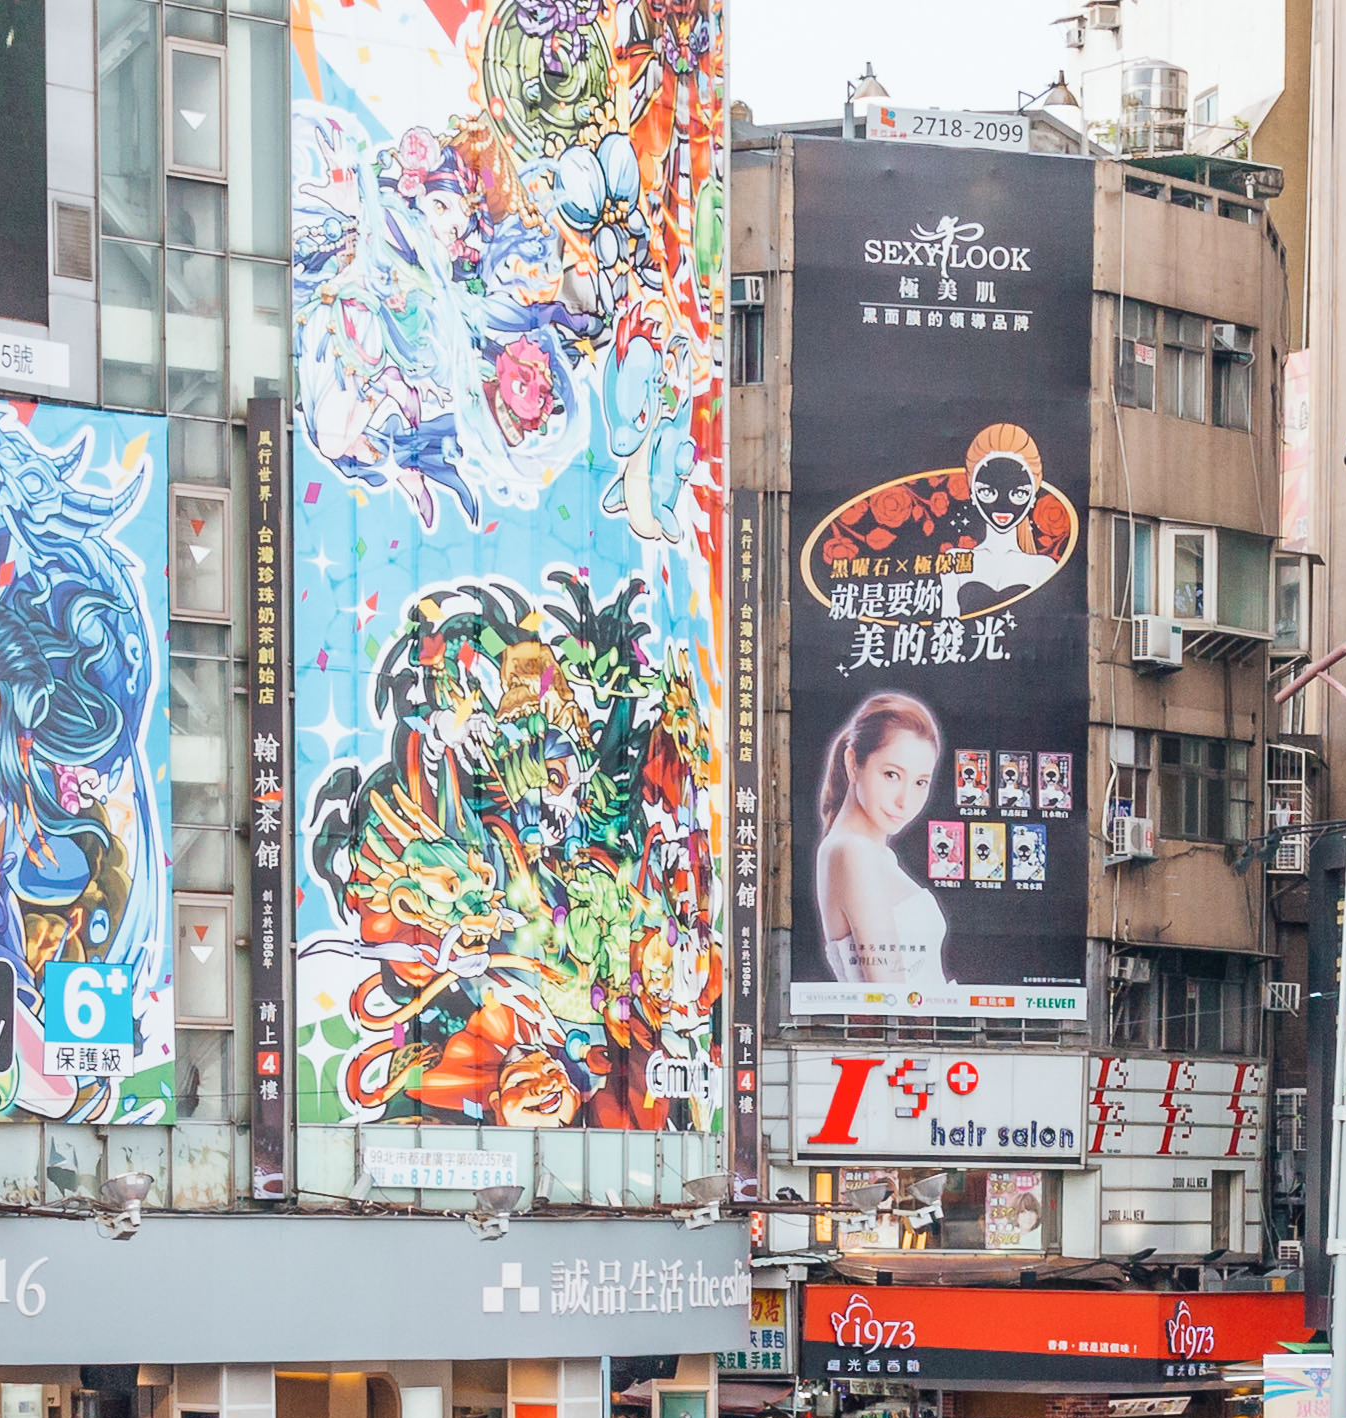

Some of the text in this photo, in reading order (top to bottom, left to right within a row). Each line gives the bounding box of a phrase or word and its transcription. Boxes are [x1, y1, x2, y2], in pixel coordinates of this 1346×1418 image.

[913, 116, 1024, 144] 2718-2099
[898, 276, 996, 304] 極美肌
[862, 307, 1030, 332] 黑面膜的領導品牌
[829, 578, 942, 621] 就是要妳
[254, 732, 282, 870] 翰林茶館
[735, 786, 758, 909] 翰林茶館
[56, 1046, 123, 1075] 保護級
[930, 1118, 1075, 1149] hair salon
[827, 1358, 921, 1374] 繼光香香雞
